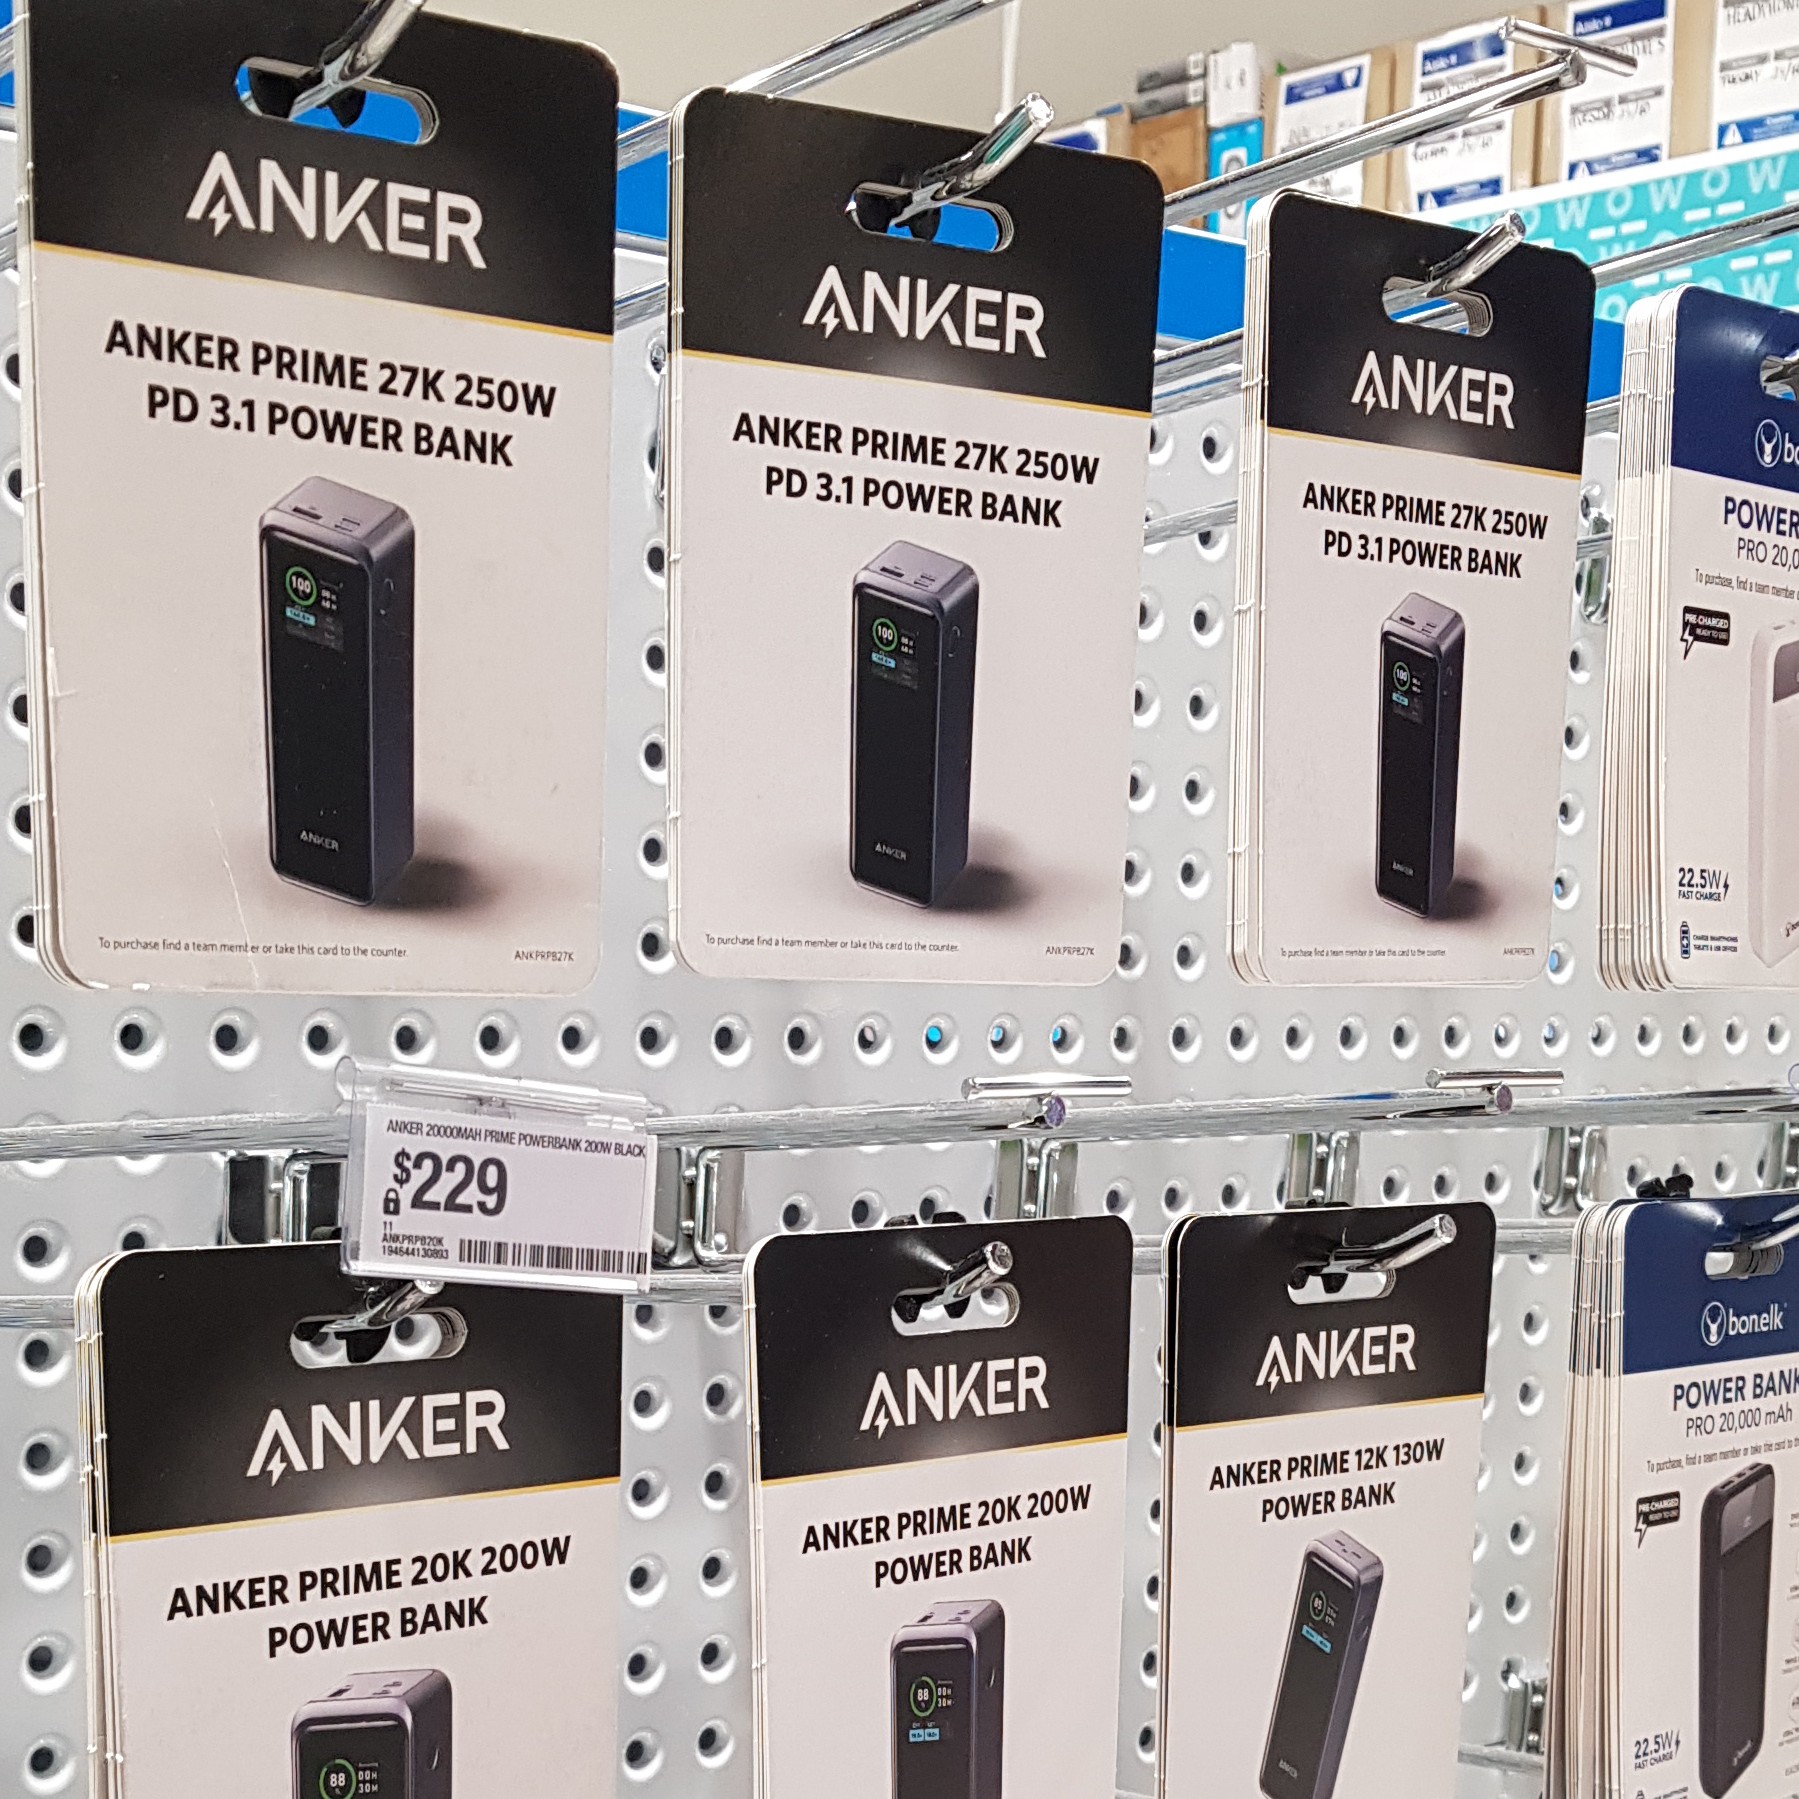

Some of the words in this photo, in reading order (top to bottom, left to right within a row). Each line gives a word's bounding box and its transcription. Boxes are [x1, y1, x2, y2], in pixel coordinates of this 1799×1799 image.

[187, 150, 487, 269] ANKER
[802, 265, 1047, 358] ANKER
[105, 319, 241, 373] ANKER
[251, 341, 368, 391] PRIME
[378, 362, 445, 402] 27K
[454, 373, 557, 418] 250W
[1351, 350, 1516, 430] ANKER
[147, 383, 199, 423] PD
[209, 393, 255, 432] 3.1
[267, 402, 403, 454] POWER
[413, 421, 513, 467] BANK
[732, 412, 842, 453] ANKER
[851, 427, 946, 467] PRIME
[954, 440, 1009, 474] 27K
[1015, 448, 1100, 485] 250W
[765, 466, 808, 498] PD
[815, 472, 853, 504] 3.1
[862, 479, 973, 519] POWER
[980, 493, 1063, 528] BANK
[1302, 482, 1377, 518] ANKER
[1382, 493, 1446, 529] PRIME
[1450, 503, 1488, 533] 27K
[1491, 508, 1549, 541] 250W
[1724, 495, 1799, 540] POWER
[1323, 529, 1353, 558] PD
[1357, 534, 1383, 563] 3.1
[1388, 541, 1463, 573] POWER
[1467, 548, 1522, 578] BANK
[1737, 537, 1768, 564] PRO
[291, 574, 312, 594] 100
[1695, 568, 1703, 583] To
[877, 625, 894, 641] 100
[1684, 613, 1729, 629] PRE-CHARGED
[300, 829, 339, 852] ANKER
[1678, 867, 1722, 889] 22.5W
[1678, 890, 1693, 900] FAST
[1695, 891, 1722, 902] CHARGE
[98, 936, 110, 948] To
[113, 938, 159, 951] purchase
[162, 939, 181, 951] find
[184, 942, 190, 951] a
[192, 942, 218, 951] team
[262, 945, 272, 953] or
[275, 944, 295, 954] take
[297, 944, 314, 955] this
[317, 945, 338, 956] card
[341, 946, 350, 956] to
[353, 945, 368, 956] the
[705, 934, 715, 945] To
[717, 935, 754, 946] purchase
[757, 935, 772, 946] find
[781, 937, 802, 947] team
[804, 938, 838, 948] member
[840, 940, 848, 949] or
[850, 940, 867, 949] take
[869, 940, 883, 949] this
[885, 941, 902, 950] card
[904, 941, 912, 951] to
[914, 941, 927, 951] the
[387, 1118, 424, 1137] ANKER
[426, 1123, 482, 1142] 20000MAH
[484, 1129, 516, 1146] PRIME
[518, 1132, 582, 1152] POWERBANK
[584, 1139, 612, 1154] 200W
[614, 1142, 646, 1159] BLACK
[393, 1147, 508, 1216] $229
[1255, 1323, 1417, 1394] ANKER
[860, 1355, 1050, 1439] ANKER
[1673, 1375, 1746, 1412] POWER
[1752, 1366, 1799, 1400] BANK
[246, 1388, 511, 1487] ANKER
[1686, 1413, 1715, 1438] PRO
[1719, 1407, 1762, 1435] 20,000
[1764, 1401, 1793, 1426] mAh
[1209, 1459, 1282, 1491] ANKER
[1287, 1450, 1350, 1481] PRIME
[1354, 1445, 1388, 1470] 12K
[1392, 1438, 1445, 1467] 130W
[1646, 1460, 1655, 1473] To
[802, 1515, 891, 1555] ANKER
[897, 1502, 972, 1540] PRIME
[978, 1495, 1022, 1528] 20K
[1027, 1483, 1092, 1520] 200W
[1262, 1488, 1336, 1523] POWER
[1341, 1481, 1396, 1511] BANK
[167, 1573, 289, 1621] ANKER
[299, 1557, 402, 1602] PRIME
[410, 1548, 472, 1586] 20K
[480, 1535, 572, 1576] 200W
[874, 1548, 963, 1589] POWER
[969, 1535, 1033, 1573] BANK
[268, 1610, 391, 1659] POWER
[399, 1595, 489, 1638] BANK
[917, 1688, 929, 1701] 88
[1634, 1729, 1674, 1759] 22.5W
[1634, 1760, 1648, 1771] FAST
[1649, 1751, 1674, 1766] CHARGE
[329, 1772, 346, 1788] 88
